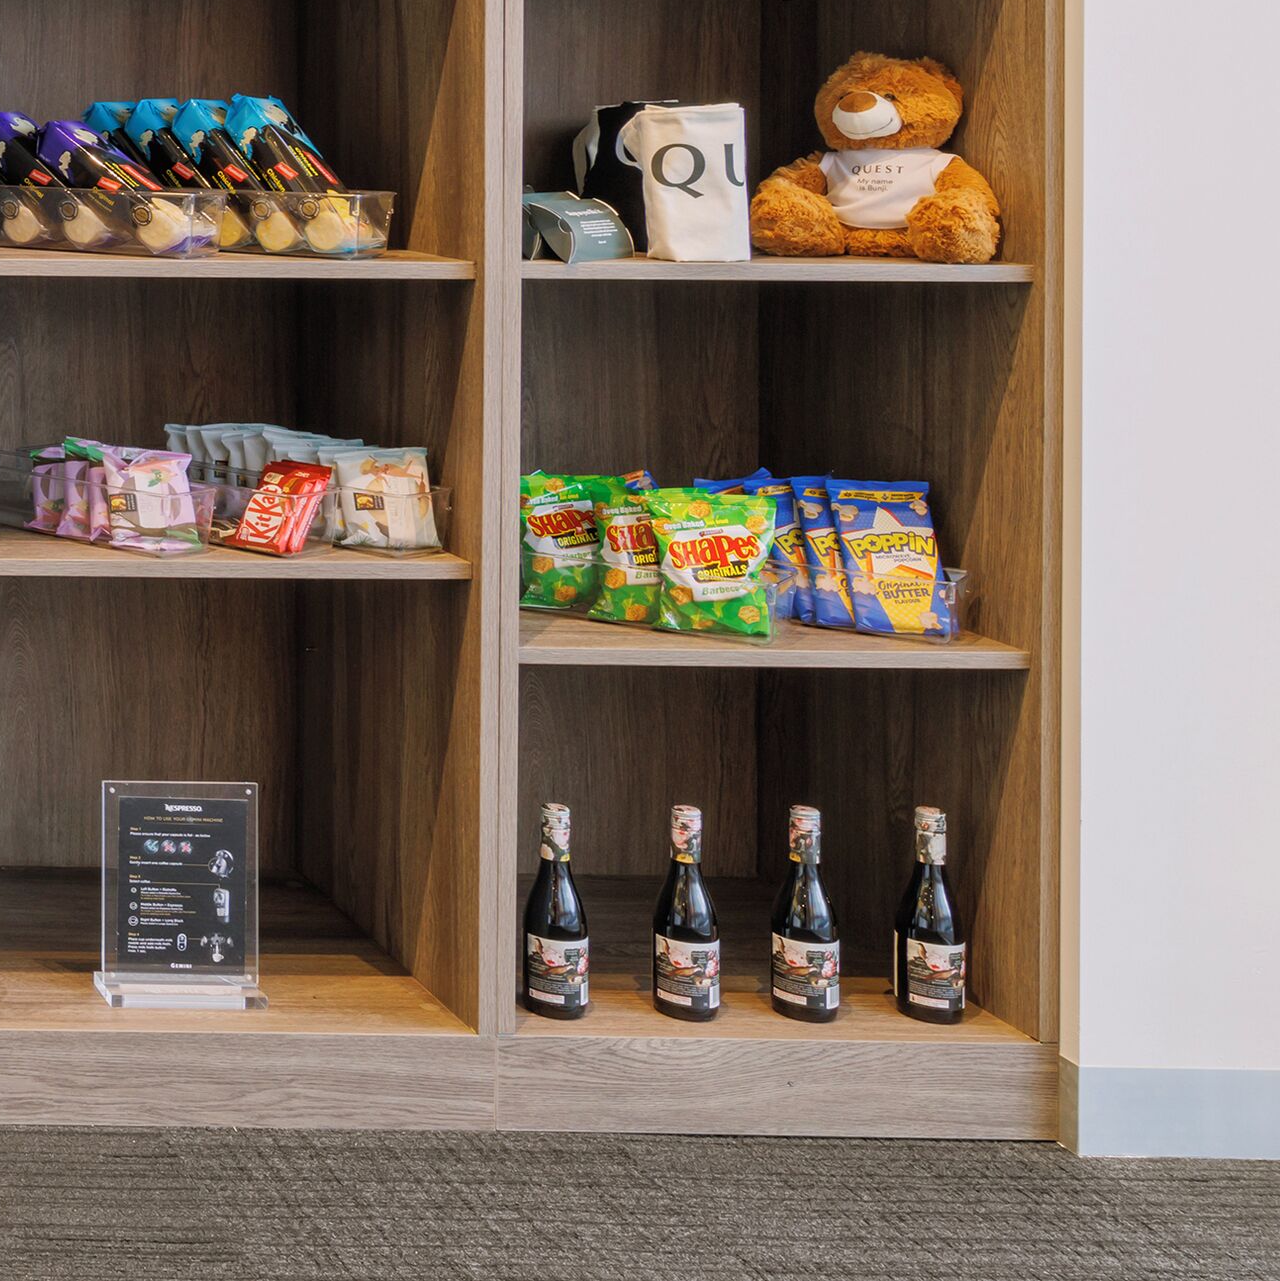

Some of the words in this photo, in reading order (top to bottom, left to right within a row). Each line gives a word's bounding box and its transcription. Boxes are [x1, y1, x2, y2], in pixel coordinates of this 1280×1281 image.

[851, 165, 904, 175] QUEST
[697, 565, 747, 580] ORIGINALS
[883, 588, 931, 600] BUTTER
[164, 804, 203, 812] NESPRESSO
